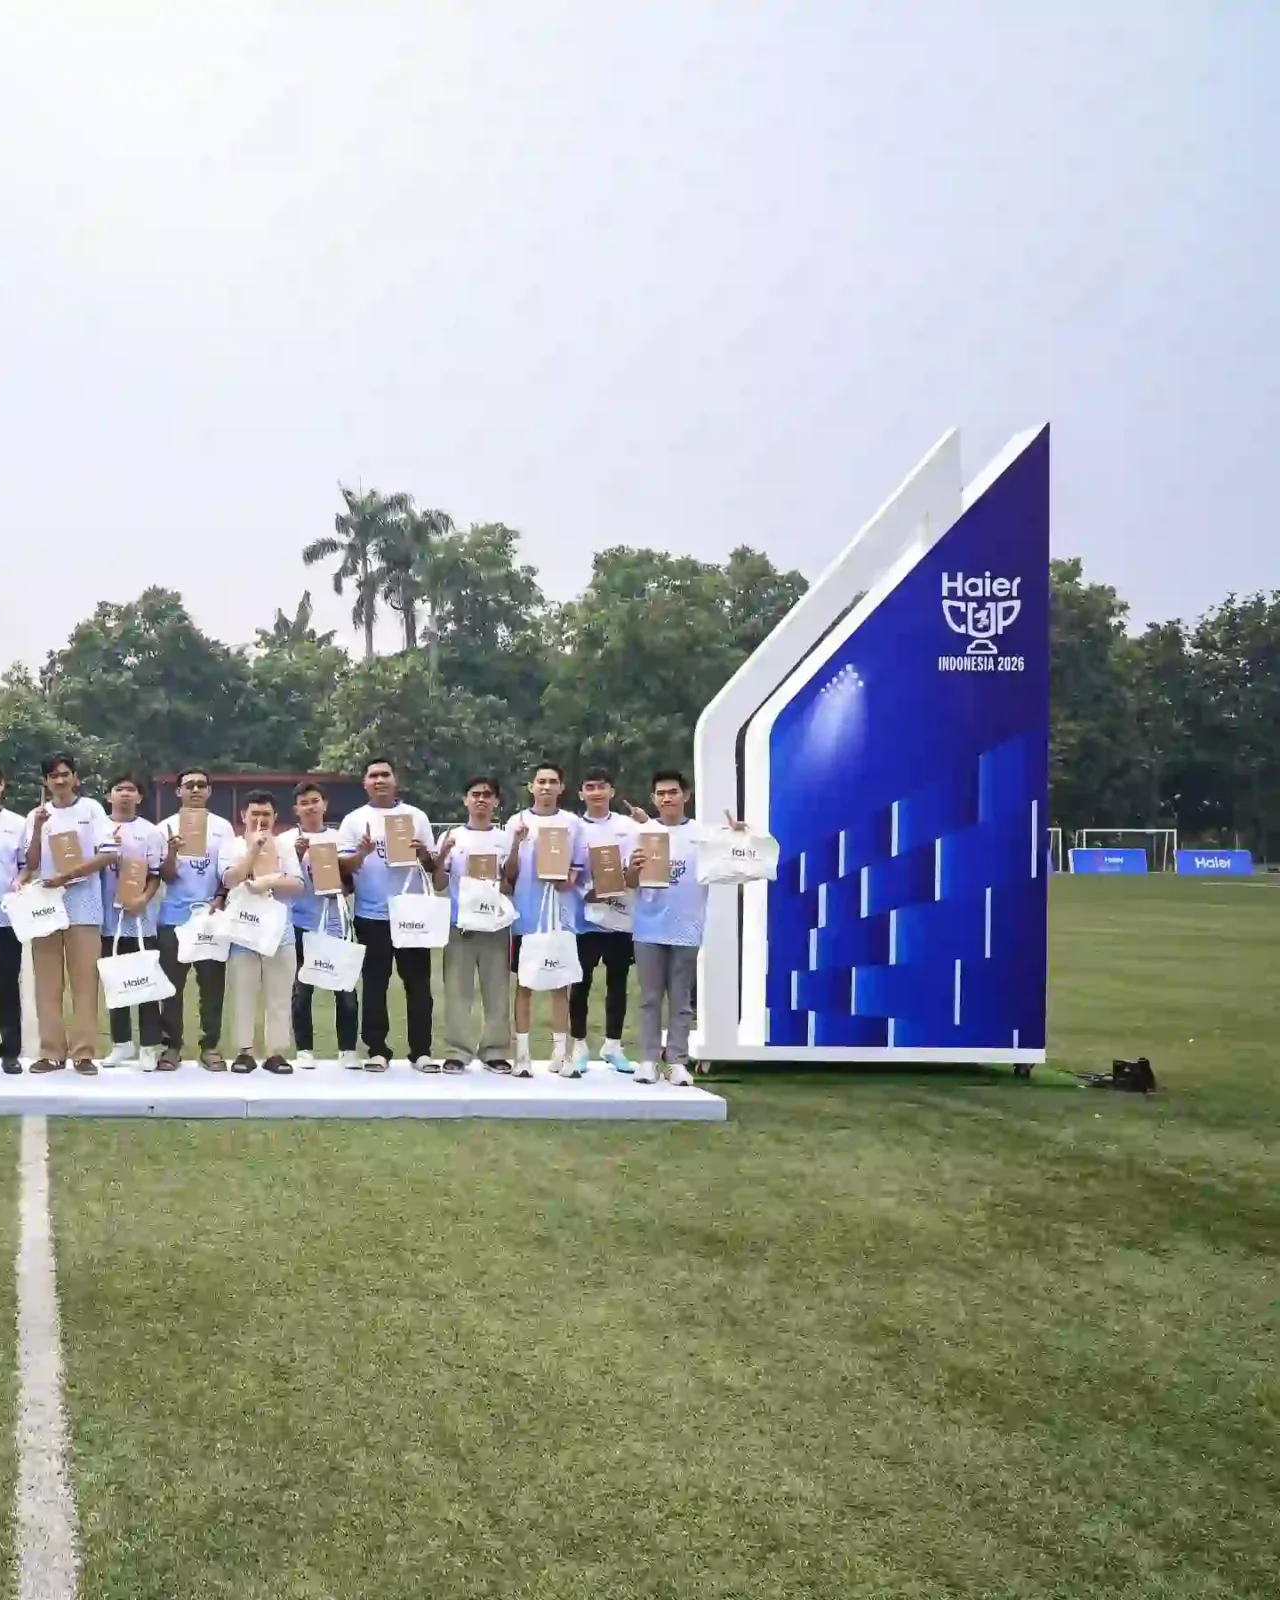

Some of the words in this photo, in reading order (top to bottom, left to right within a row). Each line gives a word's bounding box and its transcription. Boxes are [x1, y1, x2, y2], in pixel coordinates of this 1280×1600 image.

[941, 571, 1022, 597] Haier
[941, 599, 1022, 639] CUP
[938, 656, 995, 672] INDONESIA
[998, 656, 1025, 672] 2026
[1195, 857, 1232, 869] Haier
[32, 907, 57, 919] Haier
[398, 921, 426, 930] Haier
[123, 976, 150, 989] Haier
